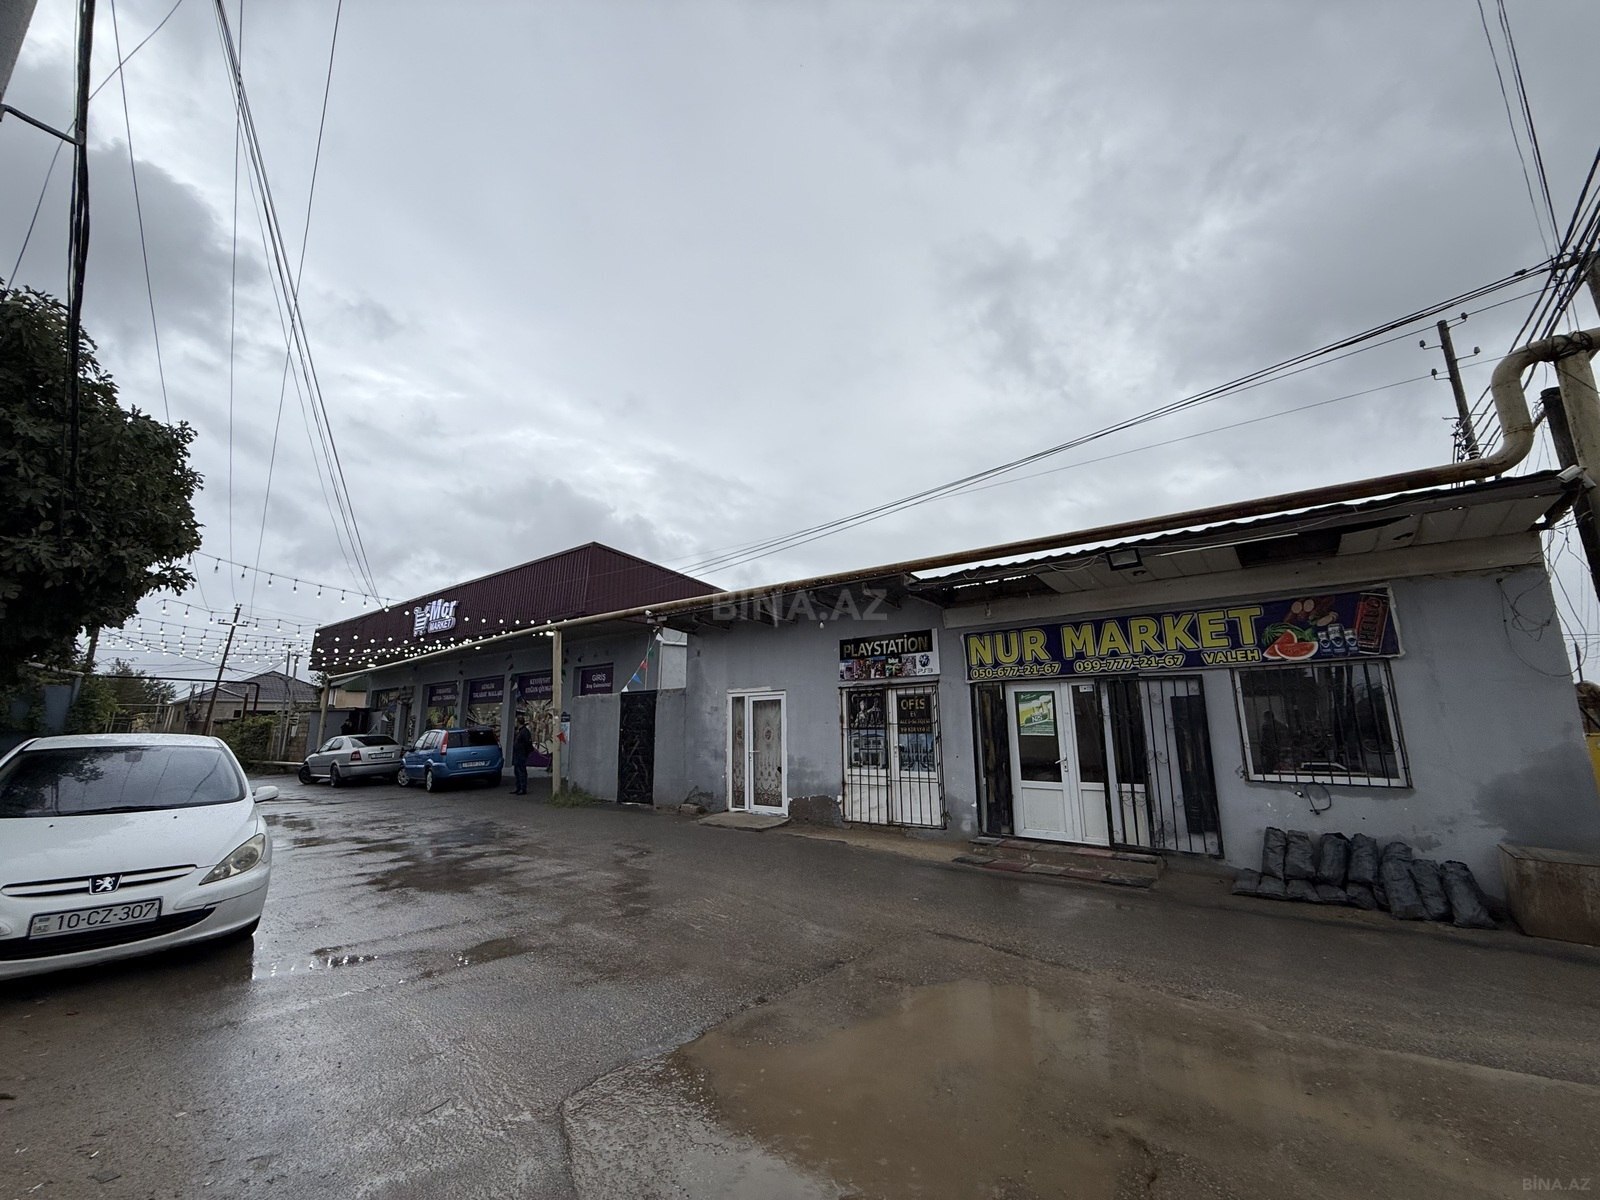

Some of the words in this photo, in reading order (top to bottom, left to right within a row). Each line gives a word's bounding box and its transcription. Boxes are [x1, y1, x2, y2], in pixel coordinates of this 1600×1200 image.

[430, 599, 457, 621] Mor
[430, 619, 452, 630] MARKET
[968, 629, 1050, 666] NUR
[1061, 606, 1263, 659] MARKET
[971, 663, 1061, 679] 050-677-21-67
[1074, 654, 1185, 673] 099-777-21-67
[1203, 648, 1261, 665] VALEH
[57, 902, 156, 930] 10-CZ-307
